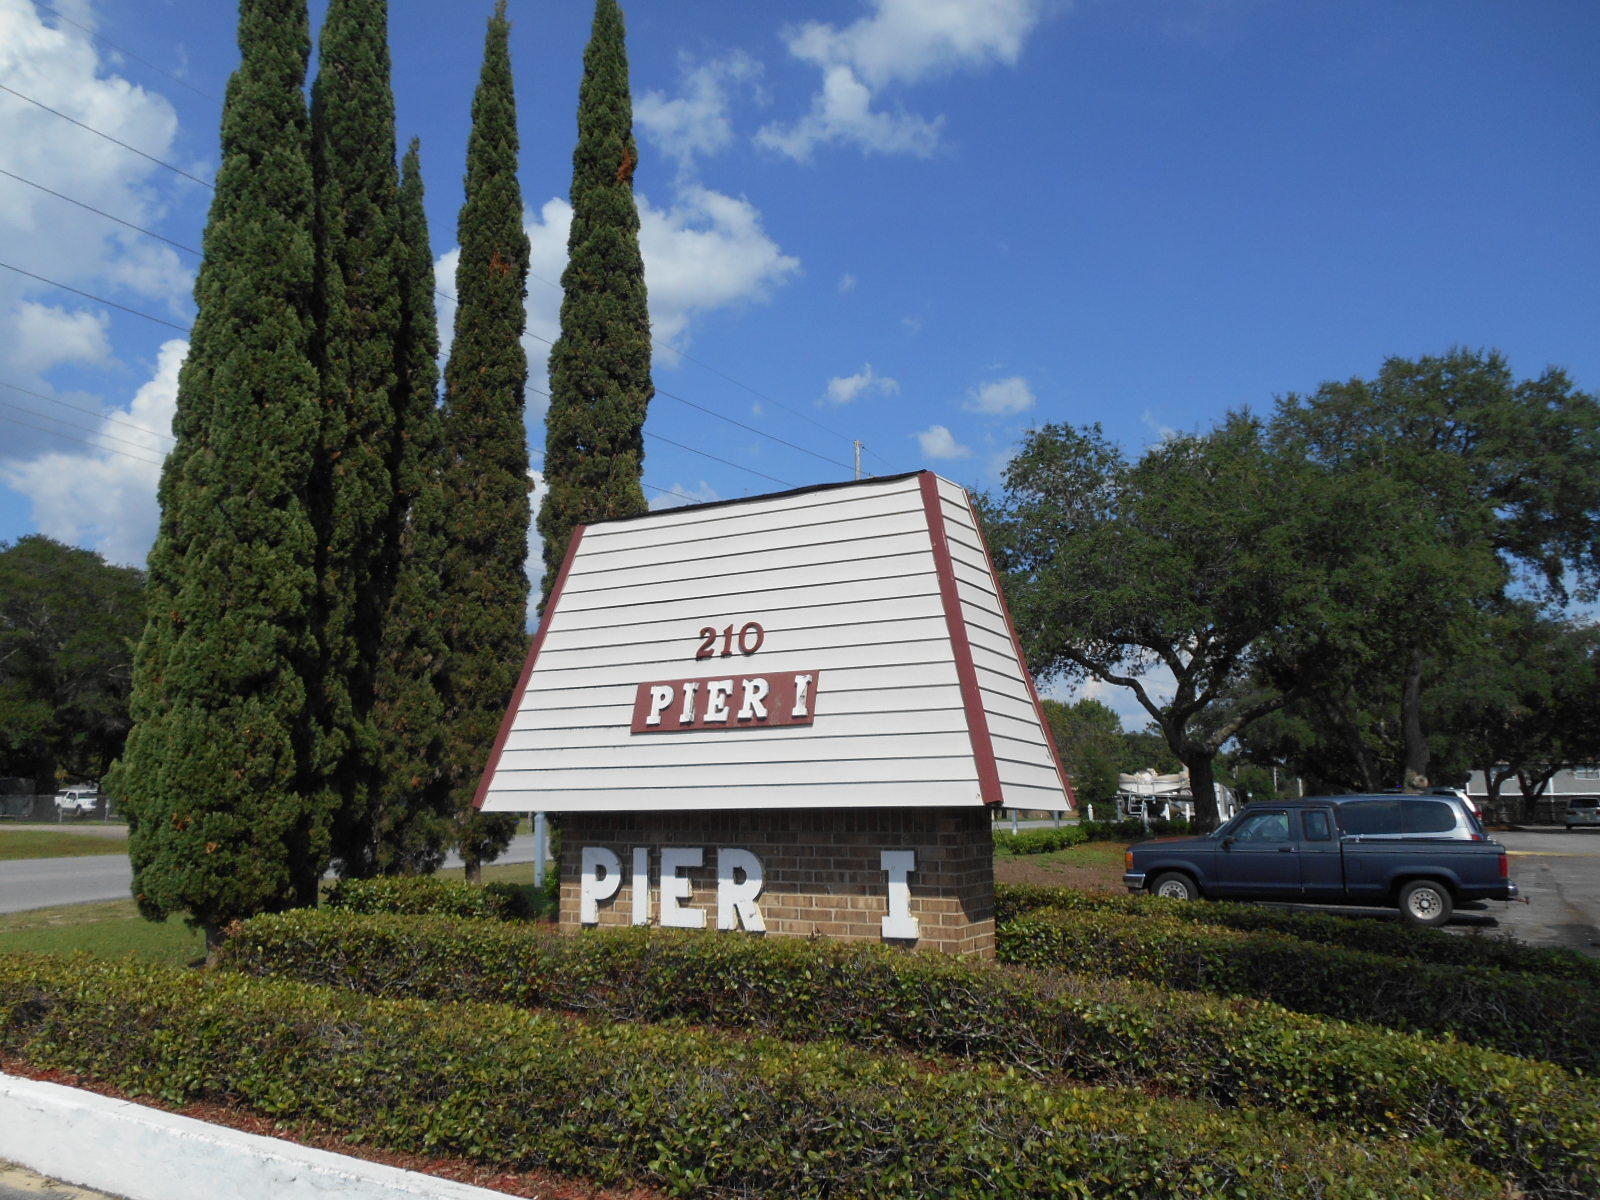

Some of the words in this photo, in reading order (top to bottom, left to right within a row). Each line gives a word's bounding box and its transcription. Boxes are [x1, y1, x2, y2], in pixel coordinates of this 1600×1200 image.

[696, 622, 765, 660] 210
[646, 678, 769, 725] PIER
[581, 847, 767, 932] PIER
[880, 850, 919, 940] I
